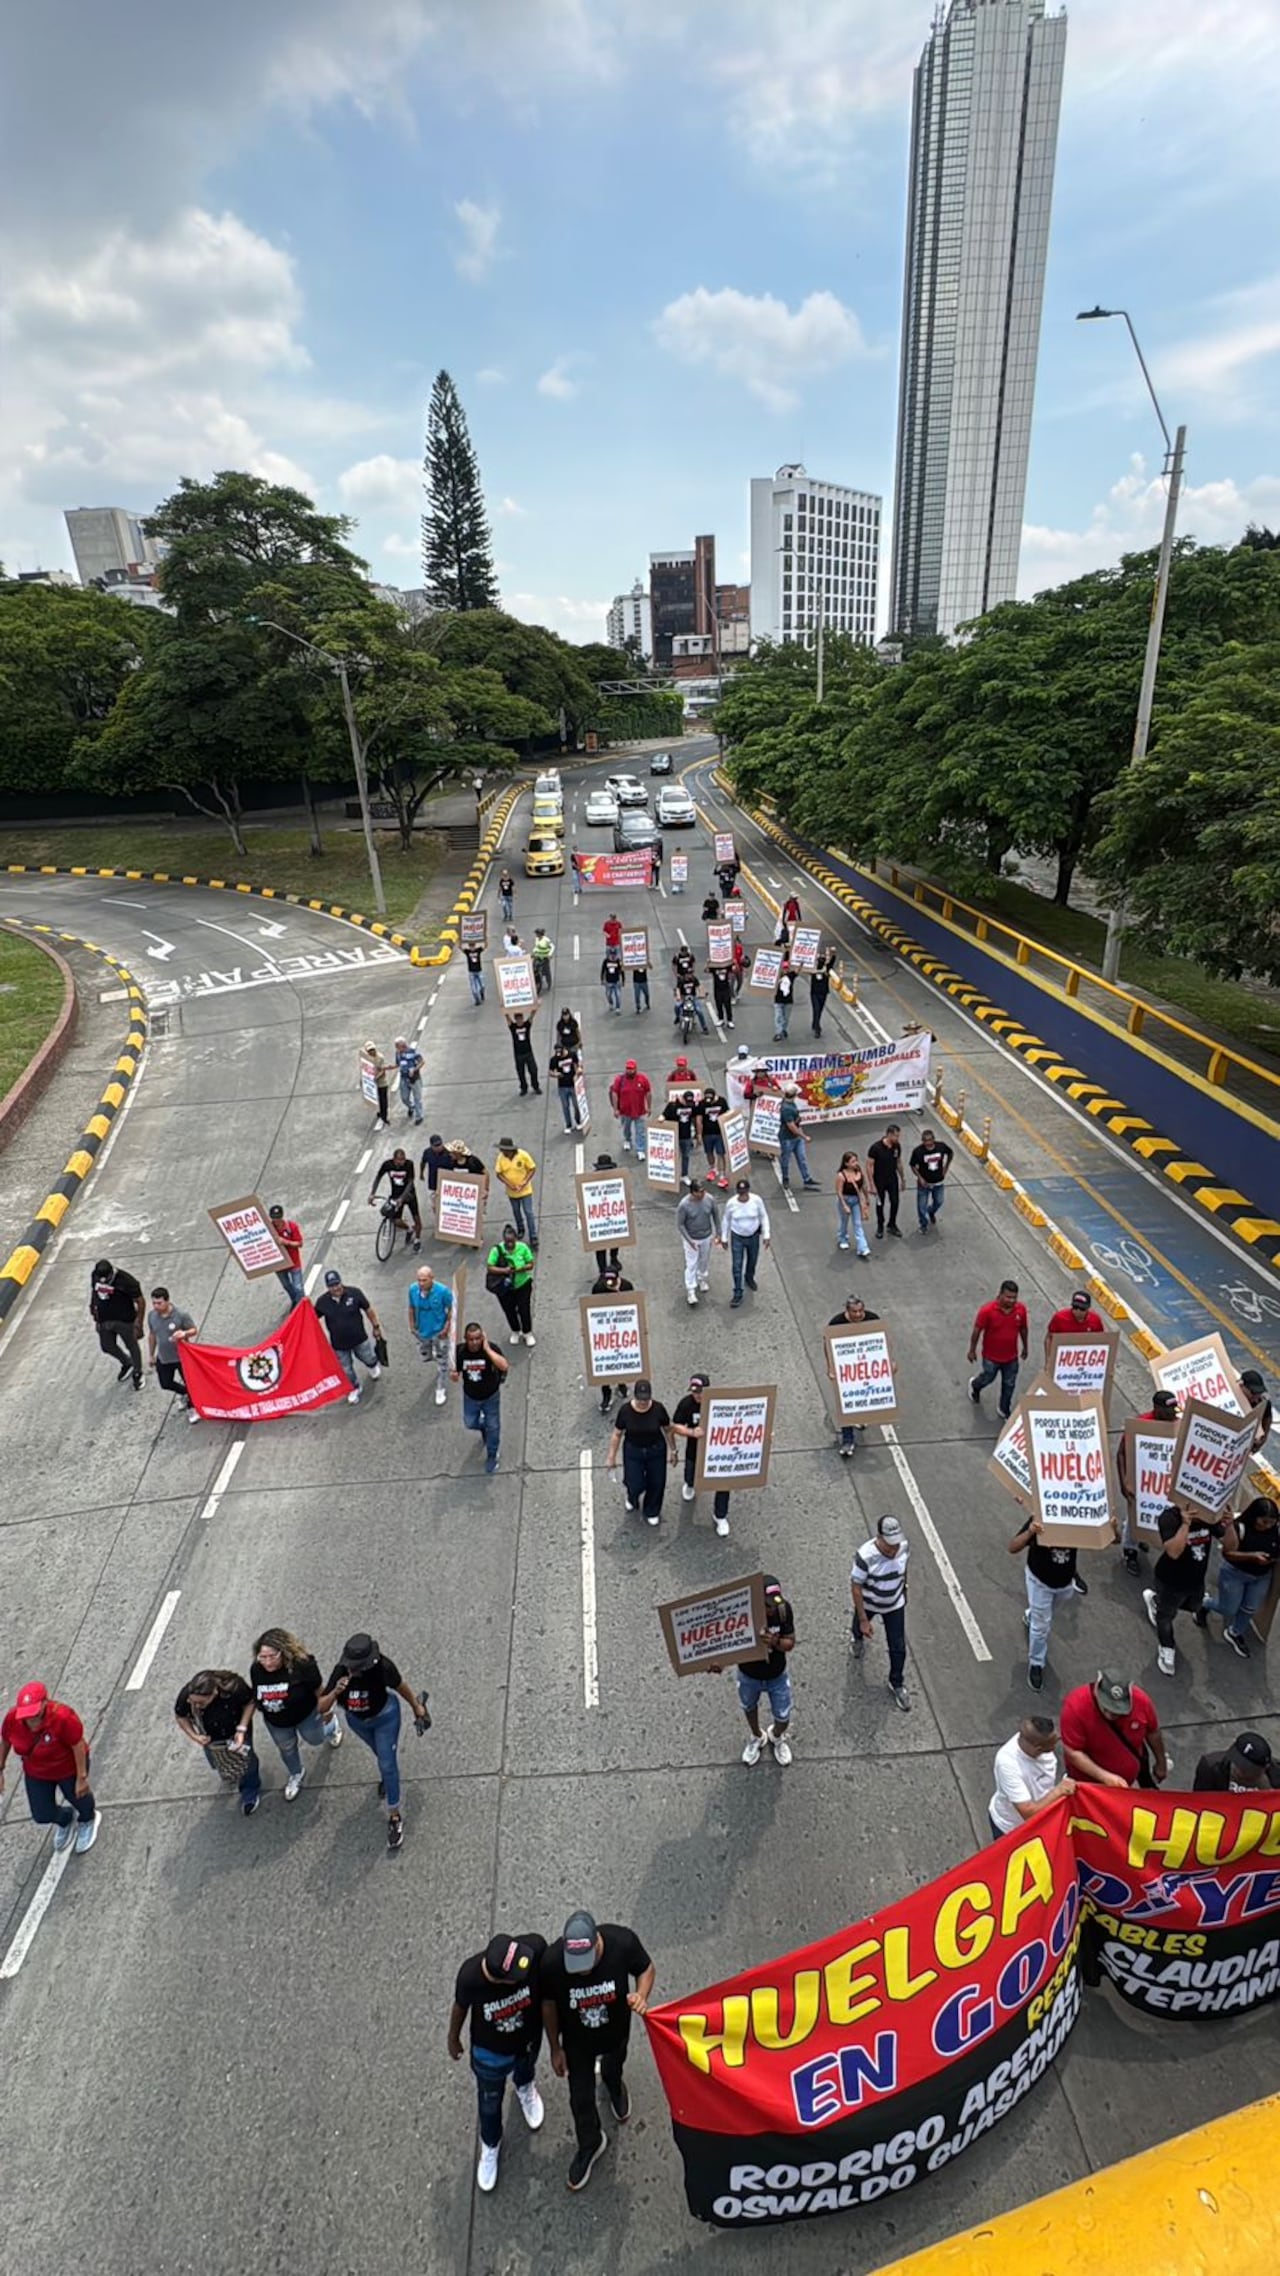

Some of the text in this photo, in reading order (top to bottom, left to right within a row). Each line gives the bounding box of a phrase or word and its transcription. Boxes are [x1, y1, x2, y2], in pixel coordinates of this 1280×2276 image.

[765, 1043, 896, 1072] SINTRAIME YUMBO
[845, 1106, 873, 1116] CLASE
[222, 1211, 262, 1234] HUELGA
[593, 1330, 639, 1351] HUELGA
[1058, 1349, 1106, 1367] HUELGA
[839, 1359, 890, 1383] HUELGA
[1034, 1418, 1060, 1428] PORQUE
[1062, 1418, 1071, 1428] LA
[1045, 1430, 1056, 1439] NO
[709, 1424, 763, 1446] HUELGA
[1066, 1441, 1076, 1452] LA
[1040, 1450, 1104, 1482] HUELGA
[1141, 1469, 1171, 1496] HUE
[1045, 1504, 1058, 1517] ES
[680, 1613, 749, 1648] HUELGA
[677, 1836, 1054, 2074] HUELGA
[483, 1985, 531, 2013] SOLUCIÓN
[569, 1980, 616, 1999] SOLUCIÓN
[729, 1939, 1280, 2192] RODRIGO ARENAS CLAUDIA
[789, 2029, 897, 2126] EN
[712, 2164, 917, 2220] OSWALDO
